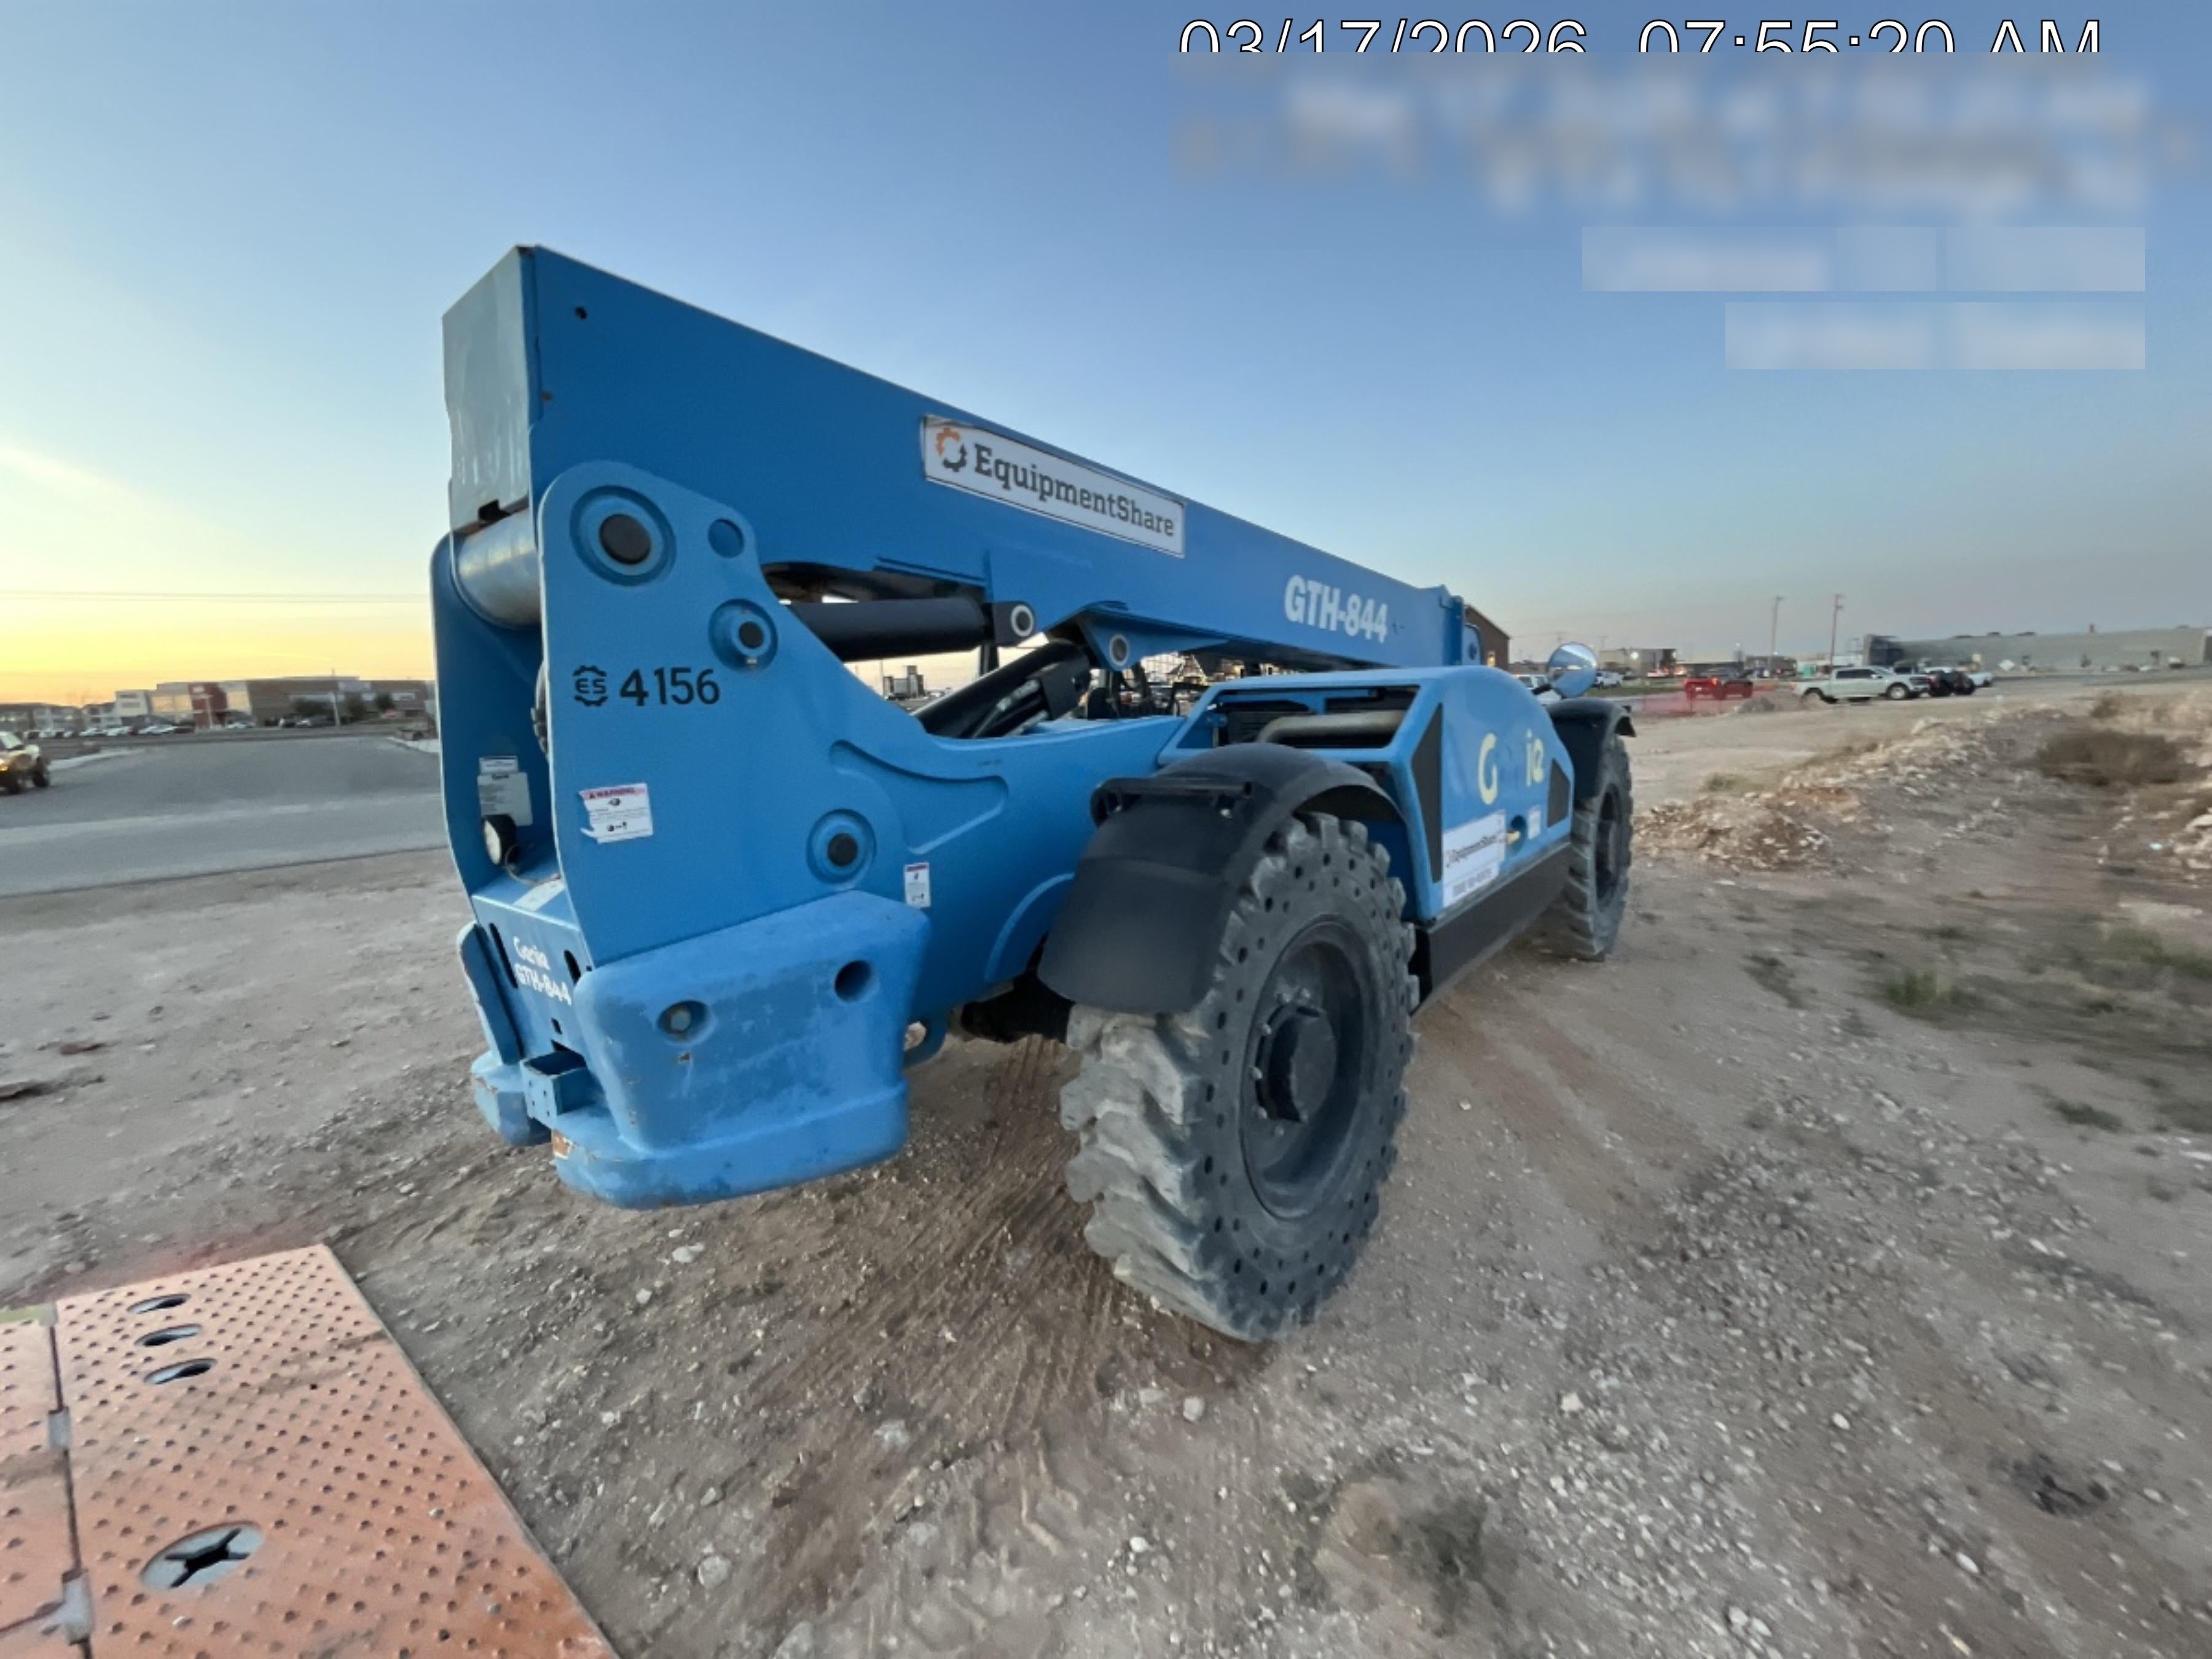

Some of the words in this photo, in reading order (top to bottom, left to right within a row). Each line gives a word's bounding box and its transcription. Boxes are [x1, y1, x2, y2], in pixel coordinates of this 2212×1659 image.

[975, 443, 1174, 537] EquipmentShare
[1284, 575, 1388, 644] GTH-844
[619, 667, 721, 707] 4156
